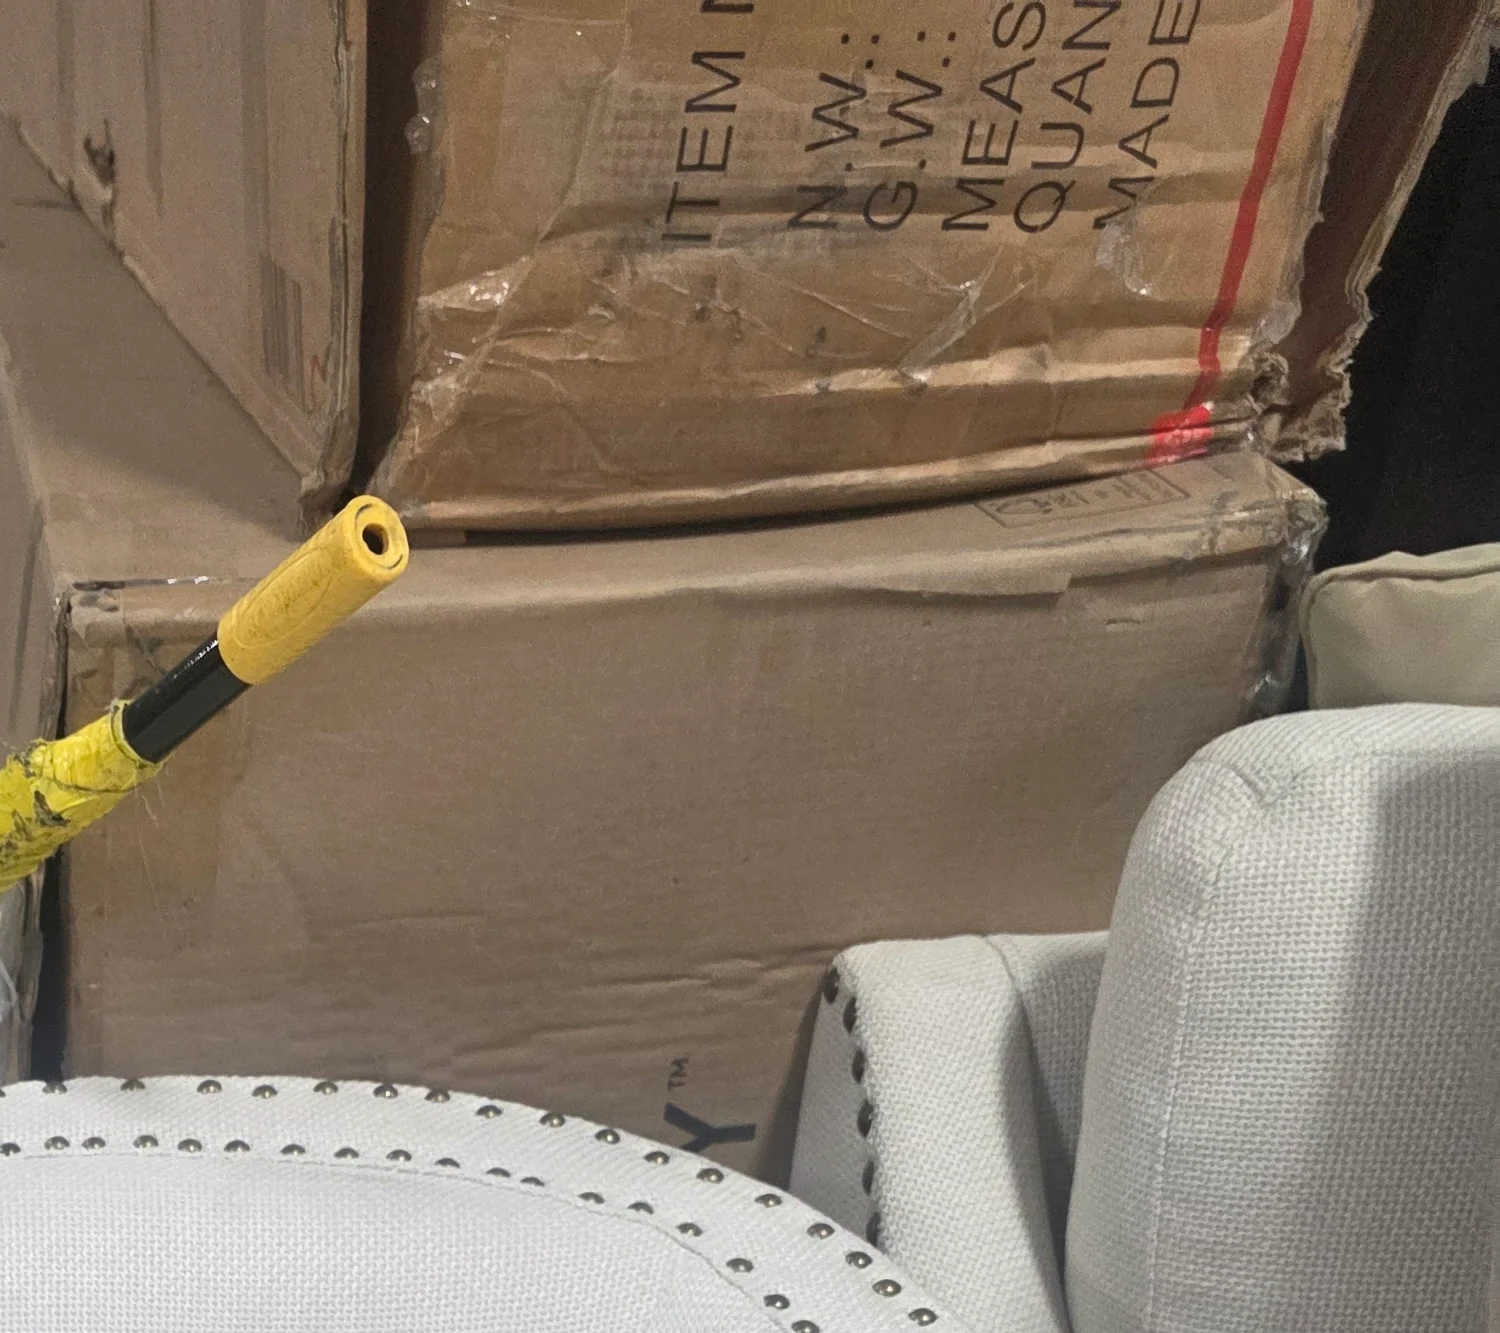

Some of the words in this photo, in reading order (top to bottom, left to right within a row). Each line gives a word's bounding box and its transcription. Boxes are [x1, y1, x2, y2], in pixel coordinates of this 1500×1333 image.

[660, 50, 747, 242] ITEM
[940, 1, 1047, 232] MEAS
[1092, 0, 1200, 231] MADE
